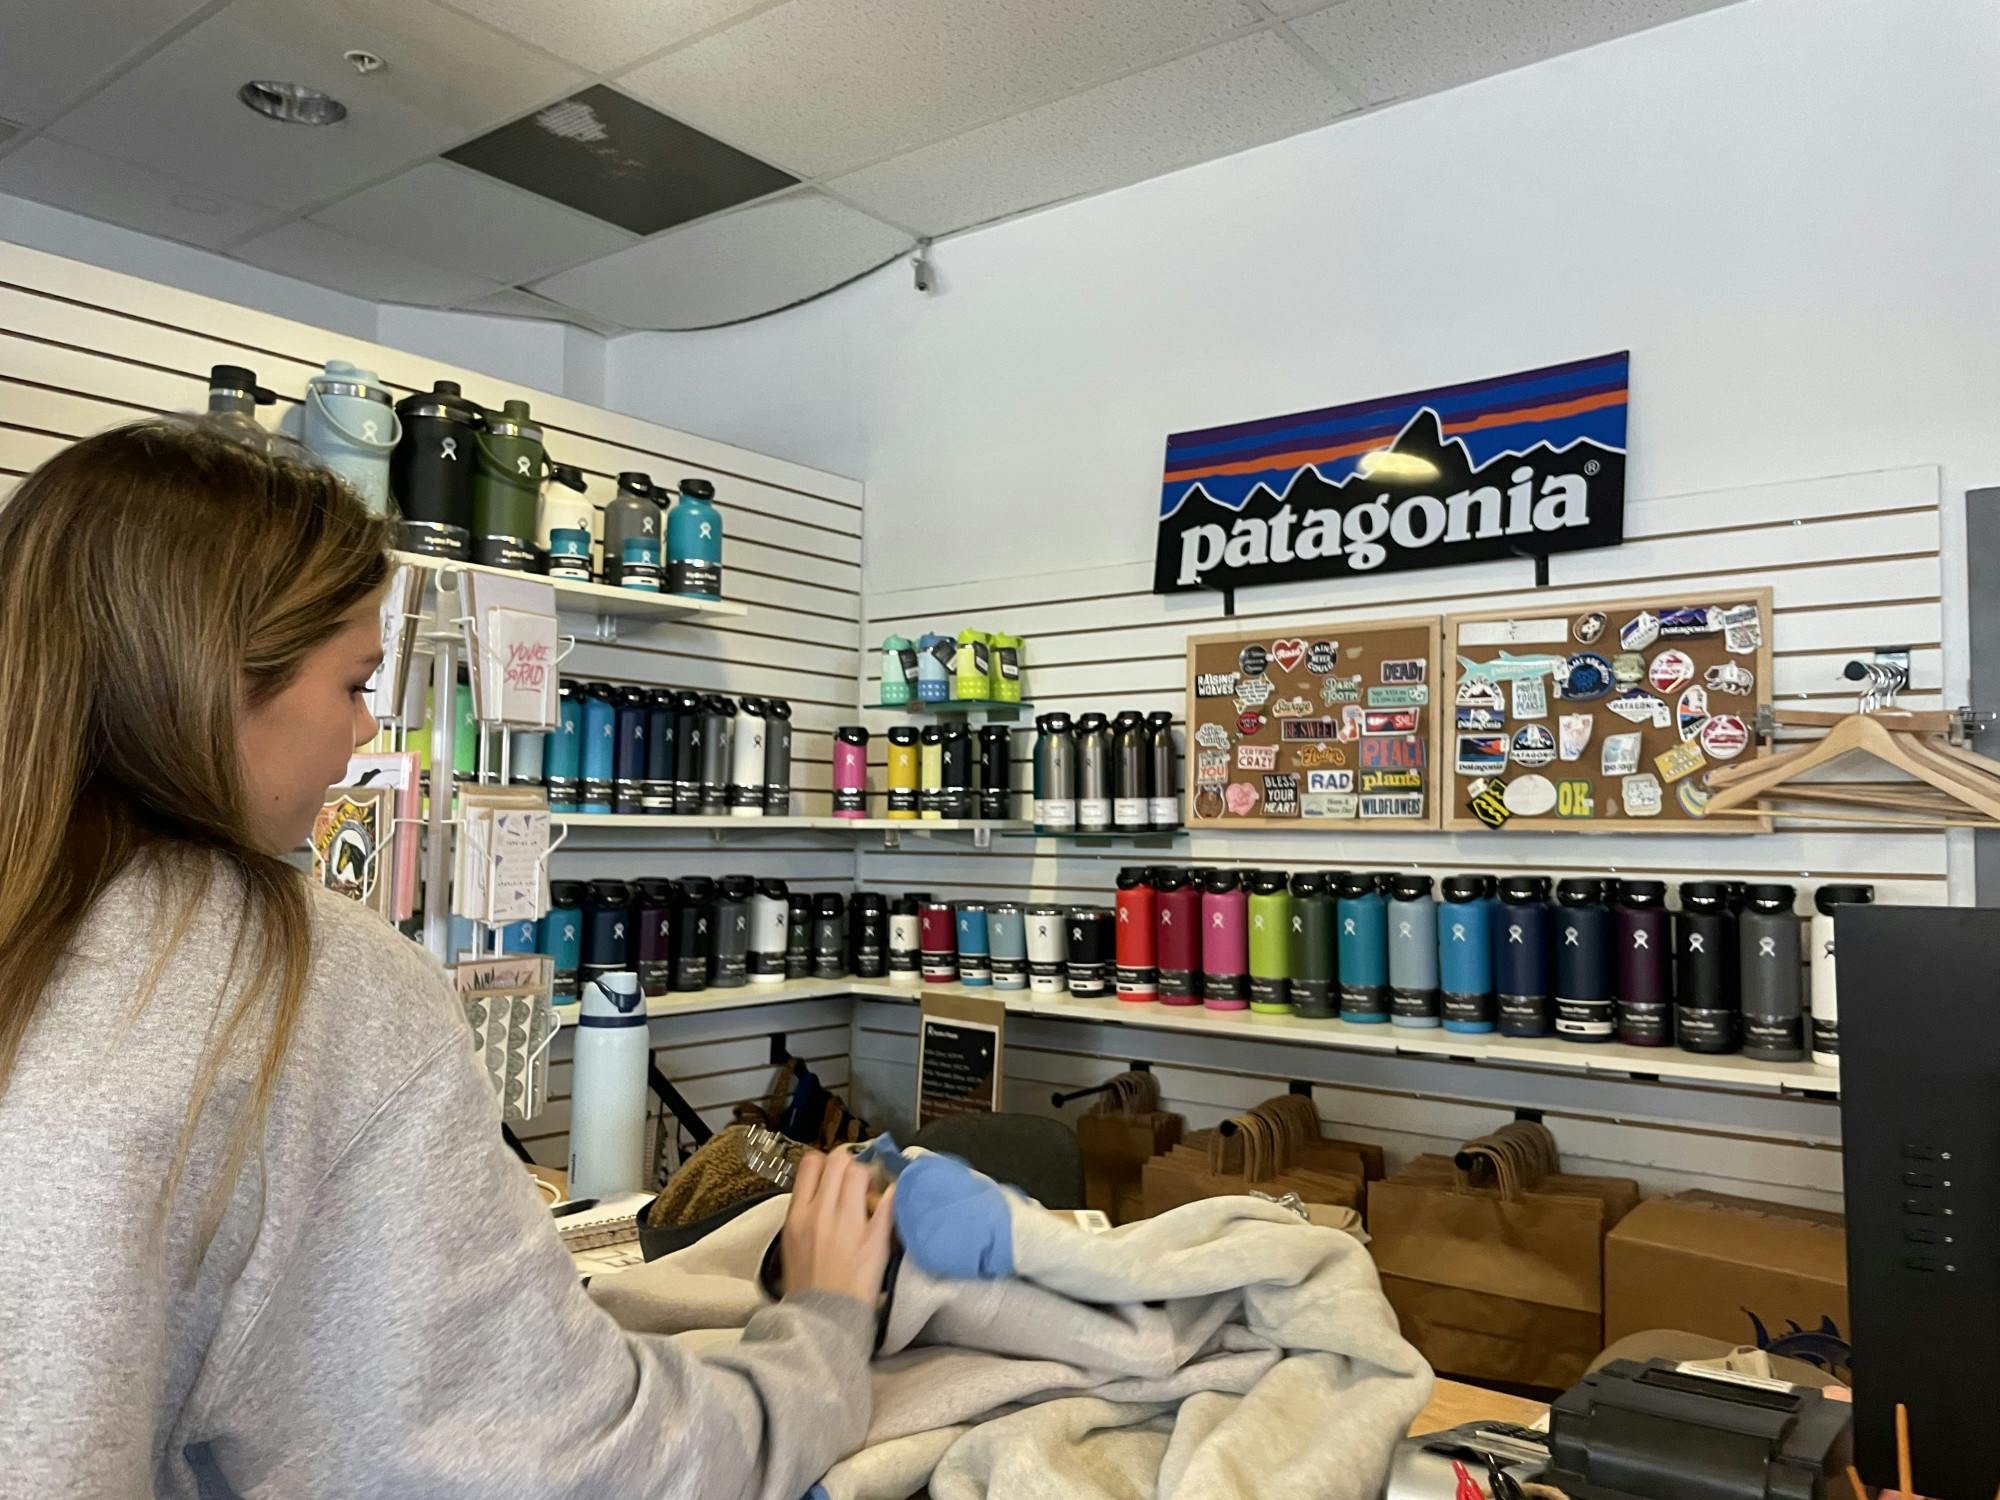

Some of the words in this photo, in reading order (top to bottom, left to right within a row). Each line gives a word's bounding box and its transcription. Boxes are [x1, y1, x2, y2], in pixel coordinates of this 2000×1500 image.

[1176, 466, 1590, 586] patagonia
[1239, 758, 1273, 768] CRAZY
[1200, 767, 1225, 777] YOU
[1264, 775, 1295, 787] BLESS
[1311, 773, 1350, 790] RAD
[1362, 770, 1421, 792] plants
[1267, 789, 1294, 801] YOUR
[1558, 782, 1590, 816] OK
[1263, 802, 1296, 814] HEART
[1361, 798, 1420, 815] WILDFLOWERS
